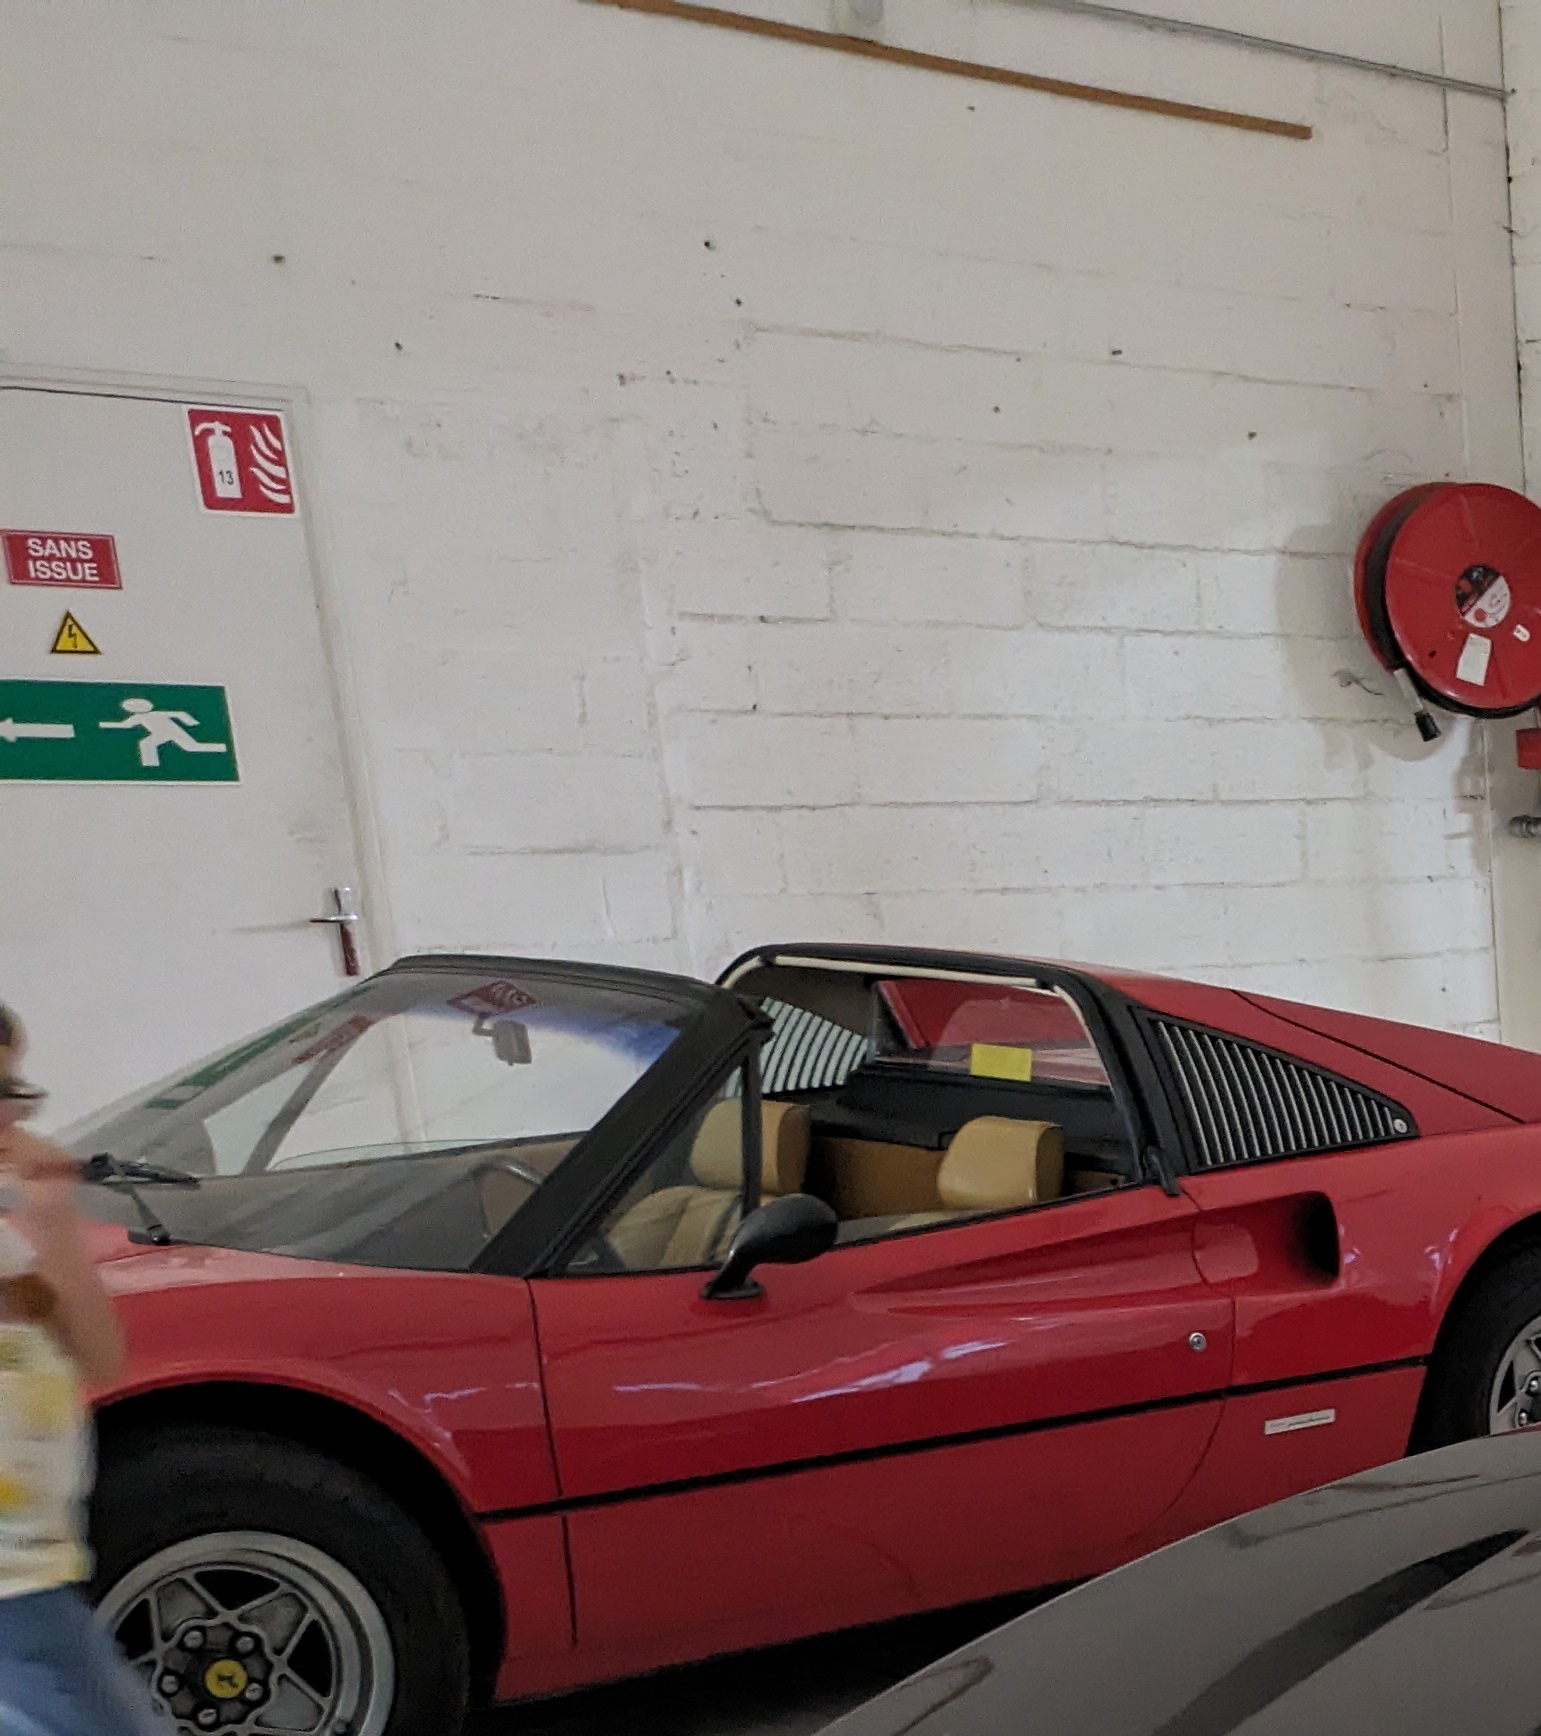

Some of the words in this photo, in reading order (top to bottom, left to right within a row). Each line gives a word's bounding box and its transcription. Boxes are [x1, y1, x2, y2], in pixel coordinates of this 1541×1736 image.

[219, 469, 234, 485] 13
[27, 538, 93, 560] SANS
[28, 560, 100, 581] ISSUE
